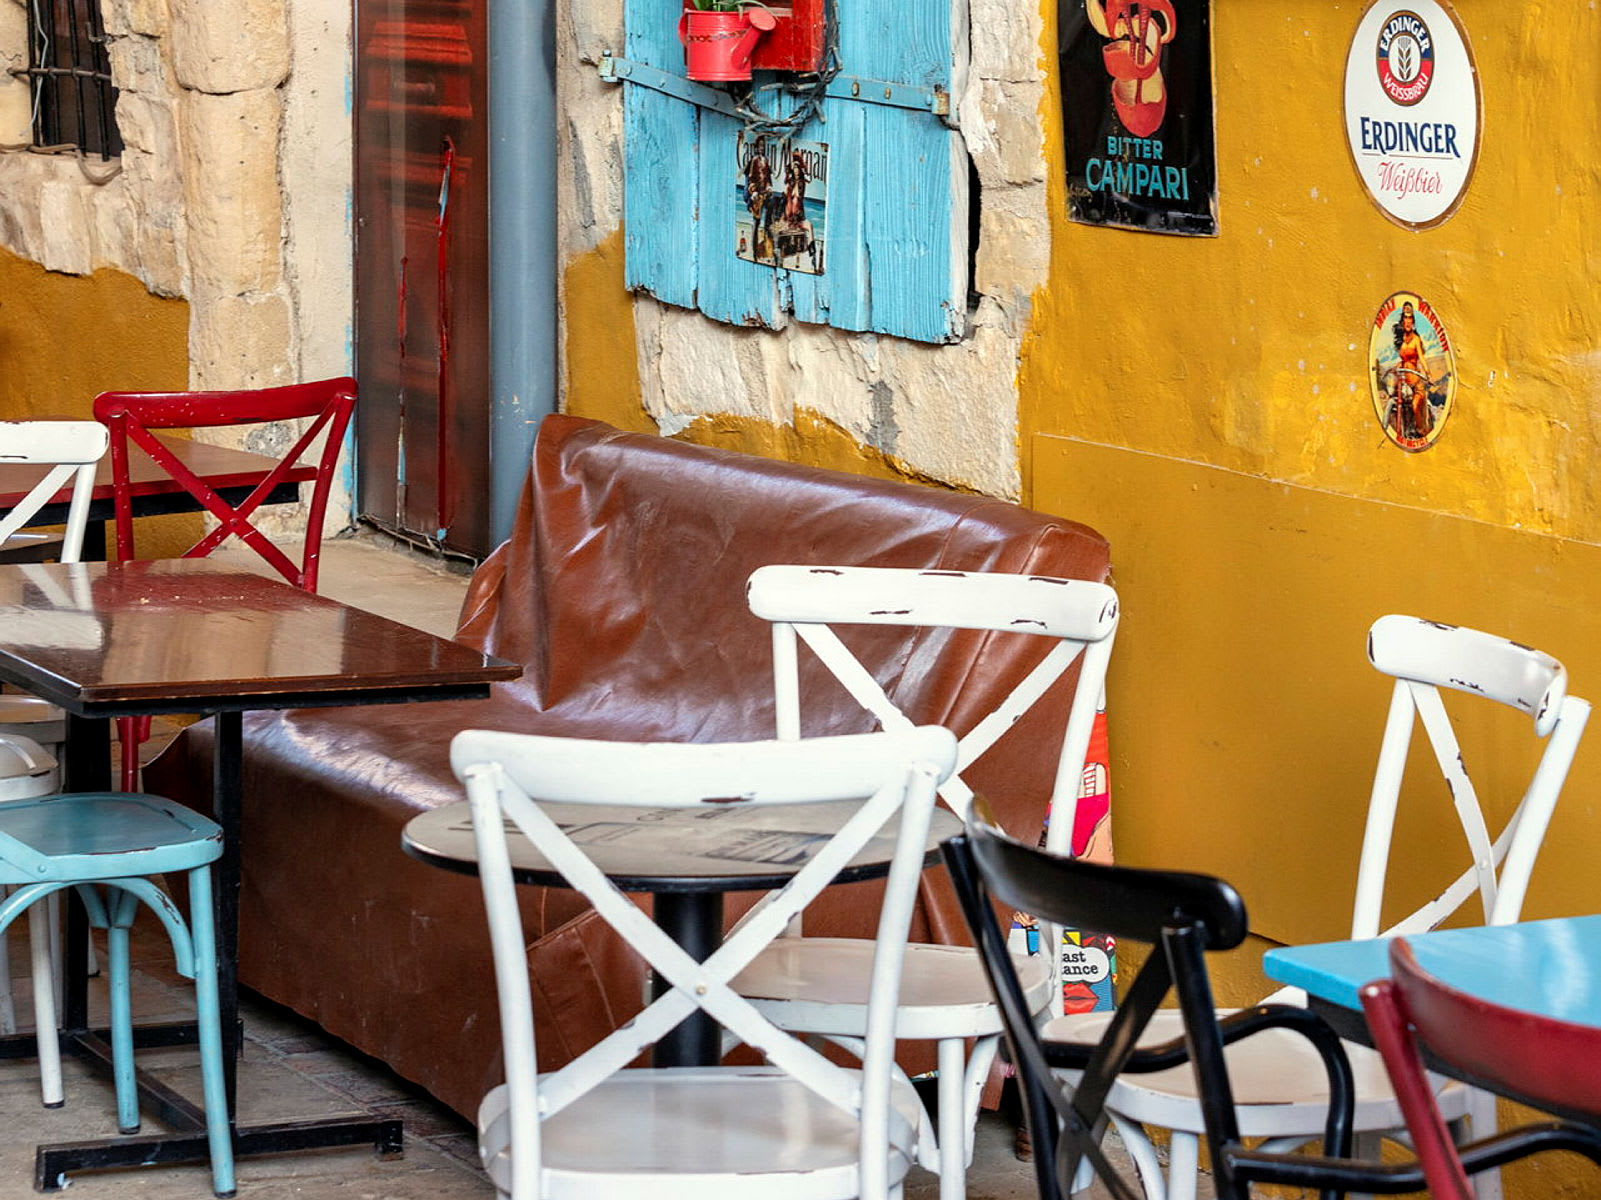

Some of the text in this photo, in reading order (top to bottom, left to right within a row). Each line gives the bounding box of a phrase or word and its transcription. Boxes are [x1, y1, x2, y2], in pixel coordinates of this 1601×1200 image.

[1379, 15, 1432, 53] ERDINGER
[1107, 136, 1164, 160] BITTER
[1360, 116, 1461, 158] ERDINGER
[1085, 157, 1190, 200] CAMPARI
[1377, 161, 1443, 200] Weißbier
[1061, 950, 1087, 963] ast
[1061, 964, 1099, 976] ance
